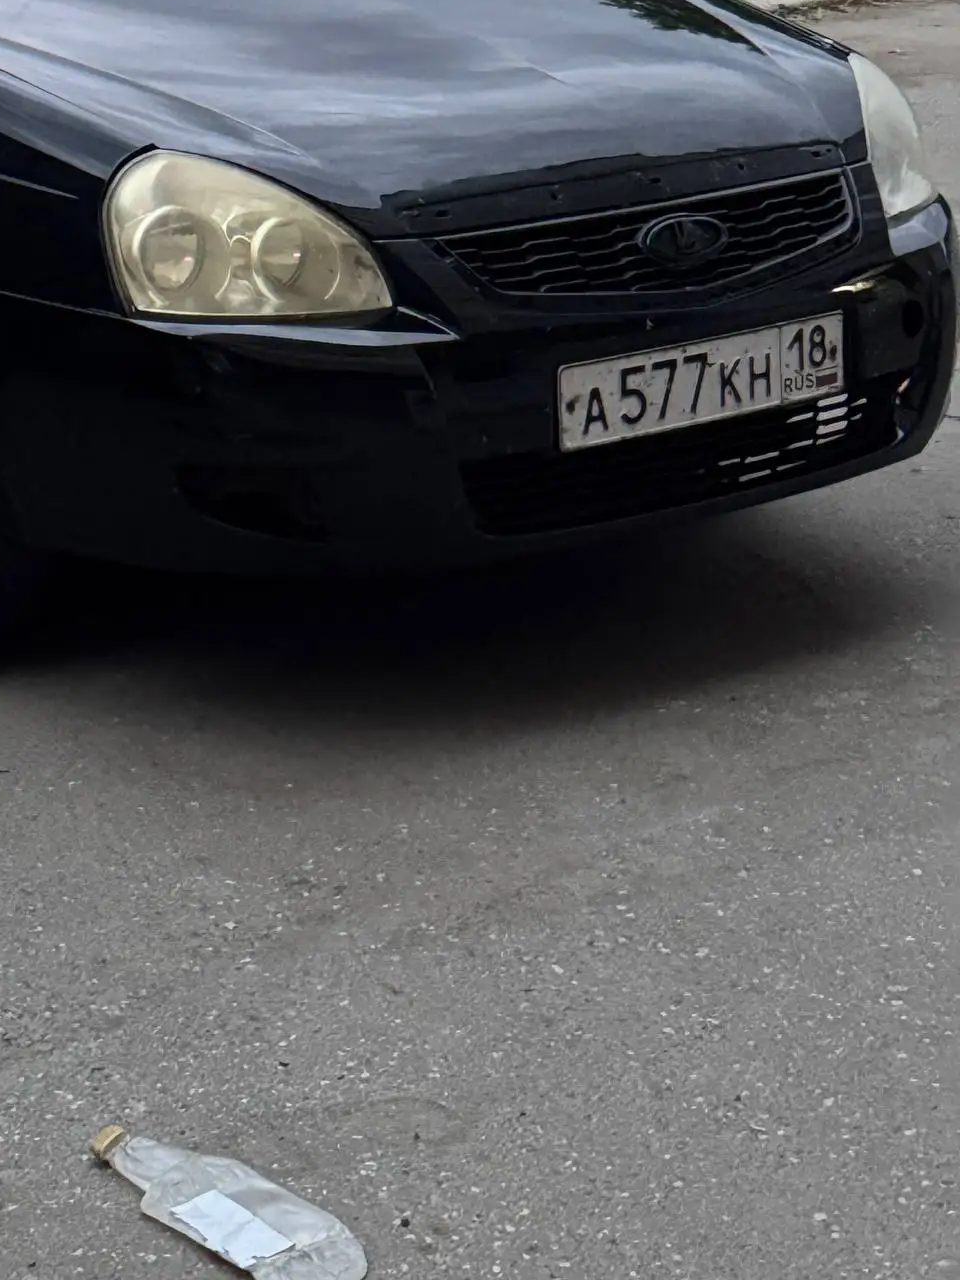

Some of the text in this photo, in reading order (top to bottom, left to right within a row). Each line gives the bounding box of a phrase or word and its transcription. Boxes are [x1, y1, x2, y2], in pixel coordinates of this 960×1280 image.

[582, 324, 827, 436] А577КН 18
[783, 373, 815, 393] RUS
